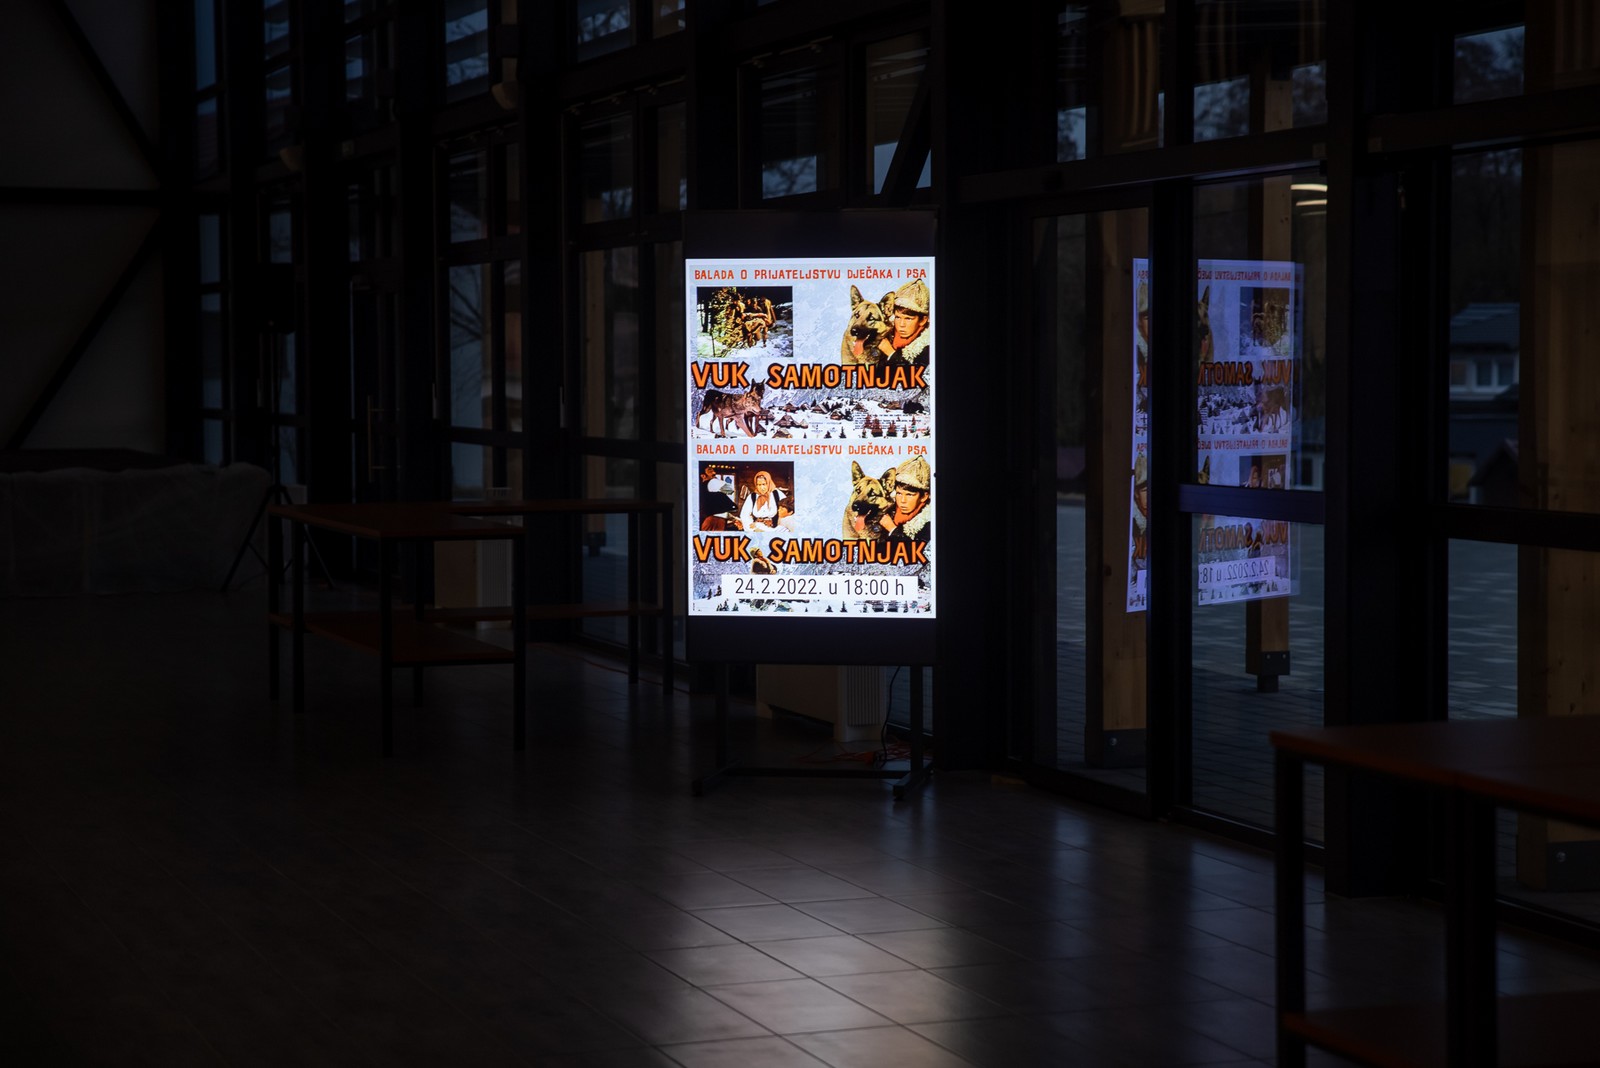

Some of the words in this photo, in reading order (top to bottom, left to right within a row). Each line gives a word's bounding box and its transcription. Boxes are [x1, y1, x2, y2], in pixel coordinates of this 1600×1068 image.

[694, 269, 734, 280] BALADA
[740, 269, 748, 280] O
[754, 269, 841, 280] PRIJATELJSTVU
[847, 266, 893, 279] DJEČAKA
[906, 268, 927, 279] PSA
[691, 361, 750, 389] VUK
[765, 361, 929, 391] SAMOTNJAK
[696, 444, 736, 455] BALADA
[742, 444, 749, 455] O
[756, 444, 842, 455] PRIJATELJSTVU
[848, 442, 894, 455] DJEČAKA
[907, 444, 928, 455] PSA
[693, 535, 751, 563] VUK
[767, 536, 929, 566] SAMOTNJAK
[734, 577, 823, 595] 24.2.2022.
[828, 582, 838, 595] u
[844, 578, 889, 596] 18:00
[895, 579, 905, 596] h
